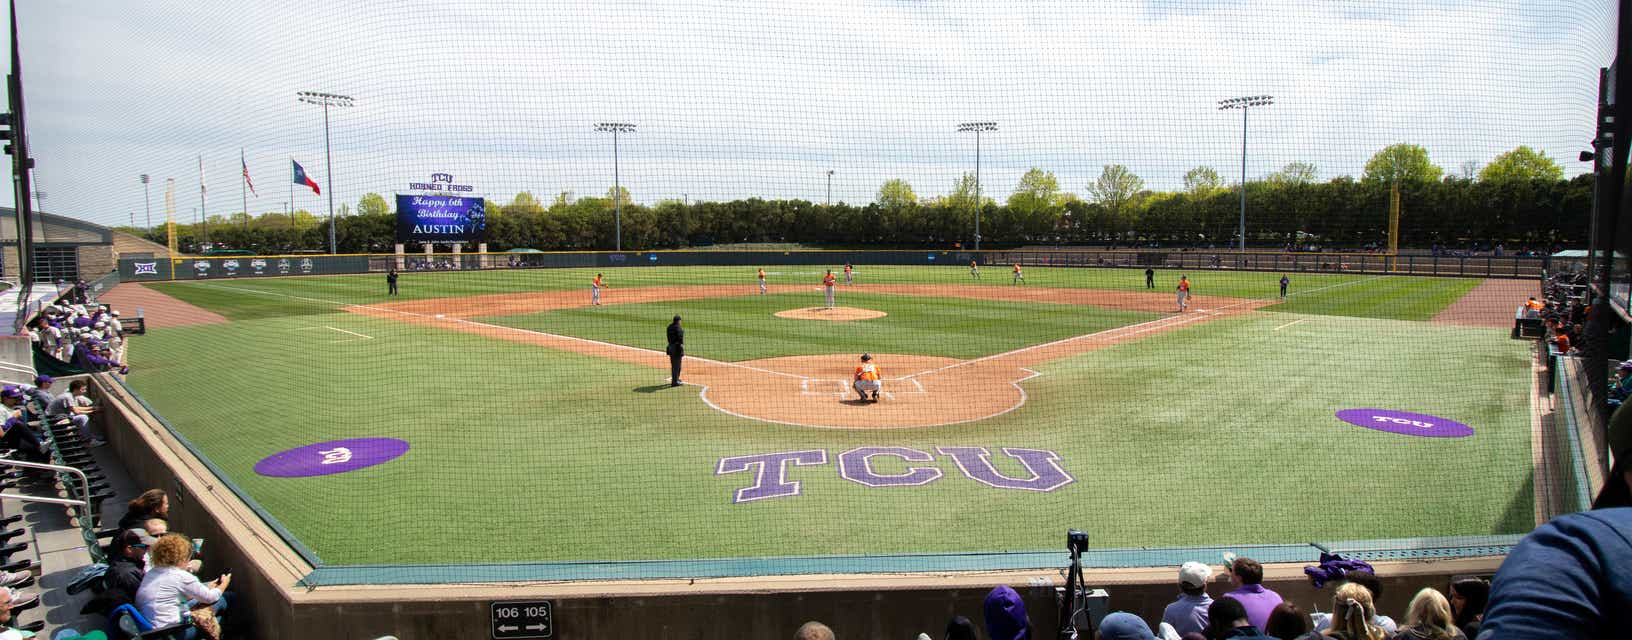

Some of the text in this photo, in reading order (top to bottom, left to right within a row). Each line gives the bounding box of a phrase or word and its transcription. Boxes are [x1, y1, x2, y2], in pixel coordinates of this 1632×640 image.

[431, 173, 453, 183] TCU
[409, 183, 442, 191] HORNED
[411, 196, 463, 208] Happy 6th
[416, 208, 459, 220] Birthday
[412, 224, 464, 234] AUSTIN
[1372, 415, 1434, 428] TCU
[714, 446, 1077, 503] TCU
[495, 606, 547, 618] 106 105
